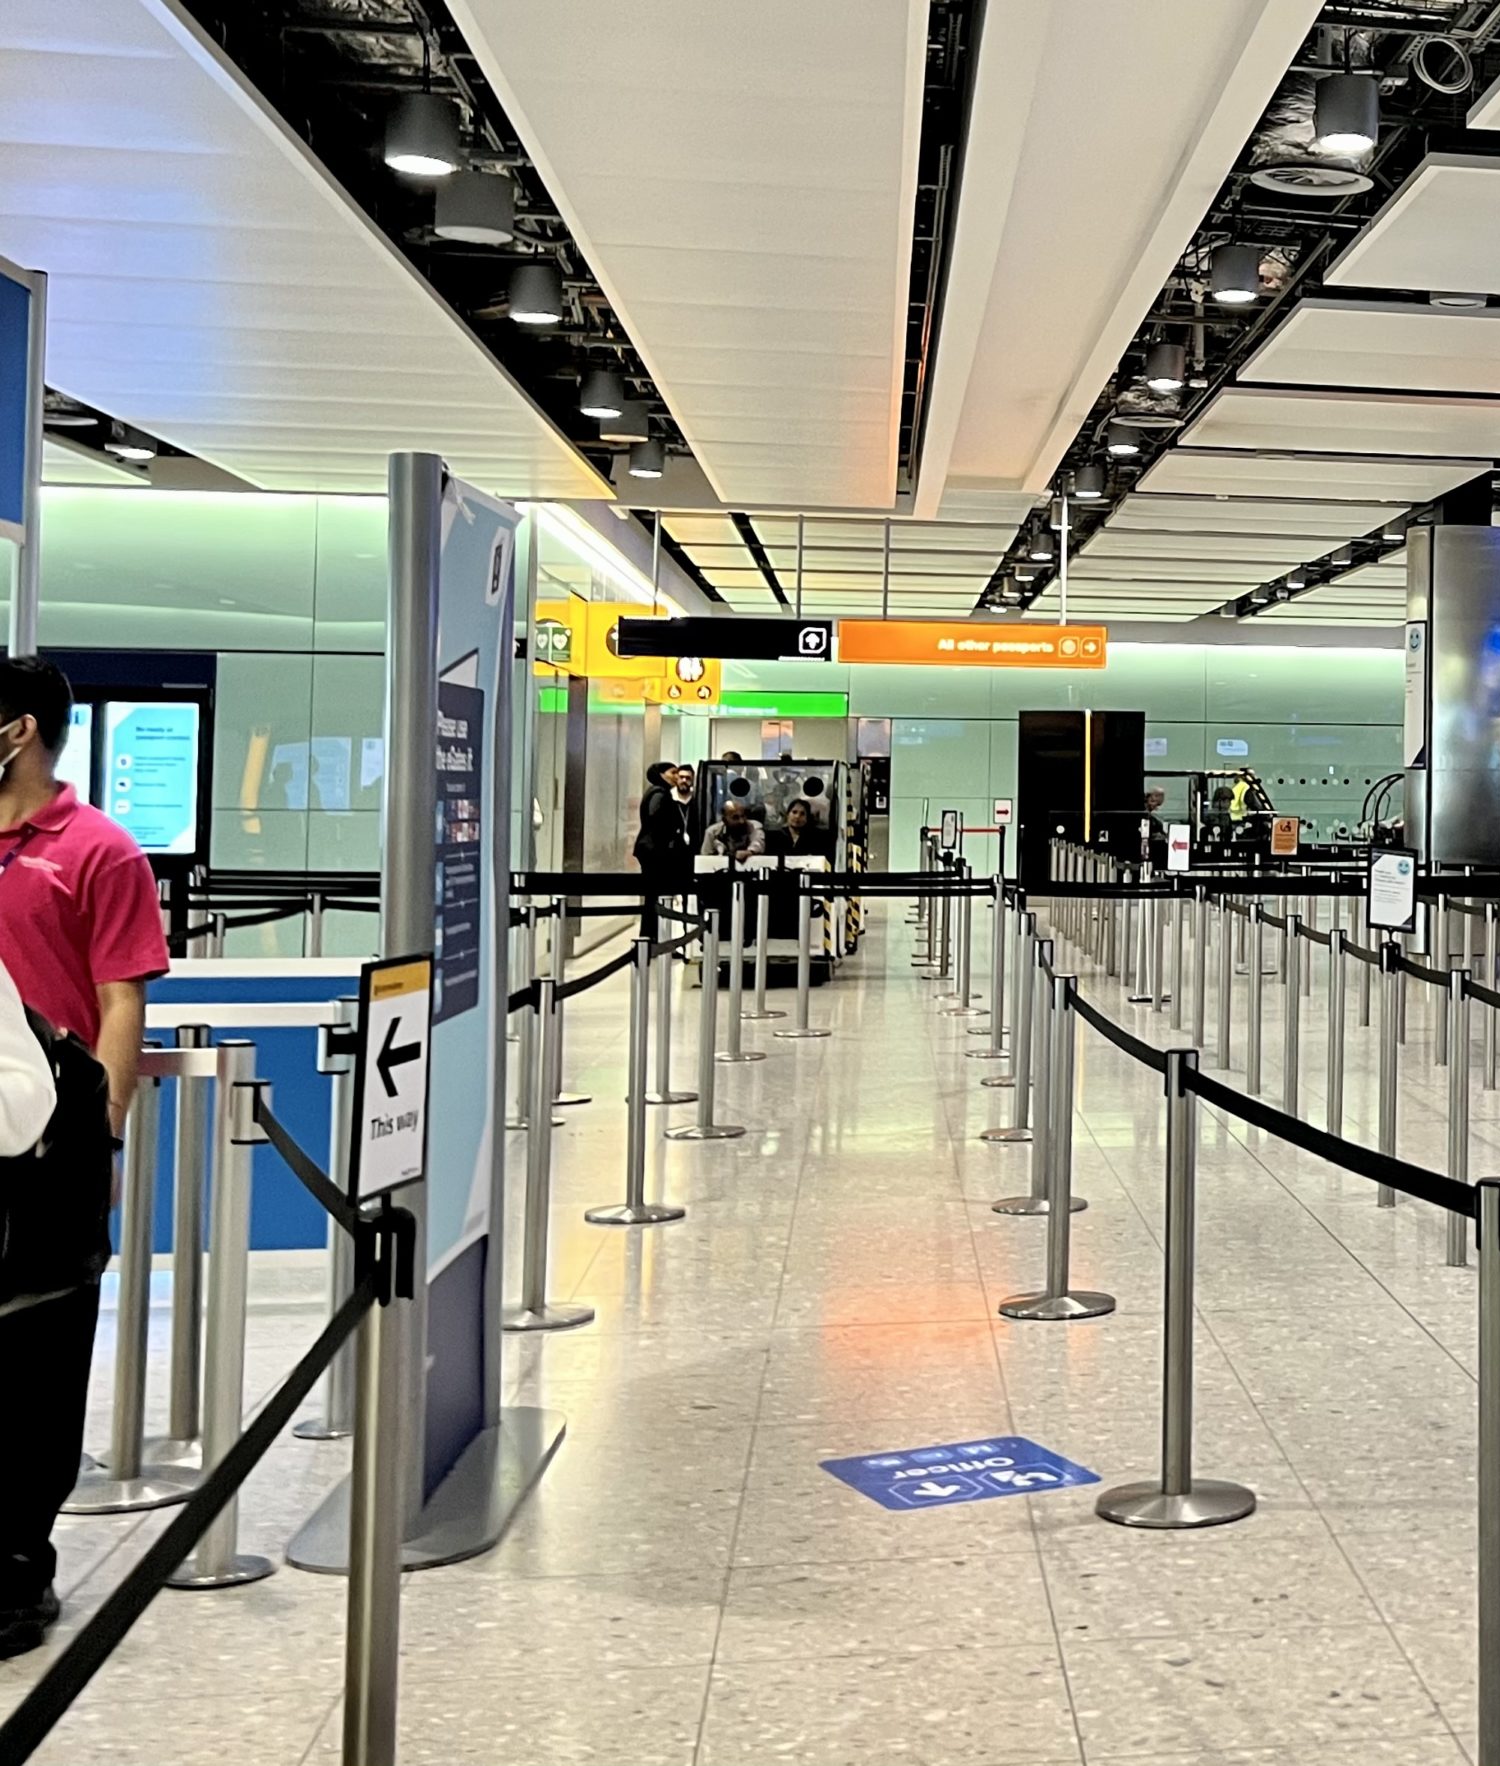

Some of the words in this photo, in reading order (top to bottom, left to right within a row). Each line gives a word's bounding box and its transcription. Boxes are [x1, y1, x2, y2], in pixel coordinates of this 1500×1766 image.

[937, 638, 955, 650] All
[956, 639, 991, 651] other
[991, 641, 1055, 654] passports
[371, 1112, 393, 1140] This
[397, 1110, 419, 1132] way
[893, 1457, 1015, 1480] Officer
